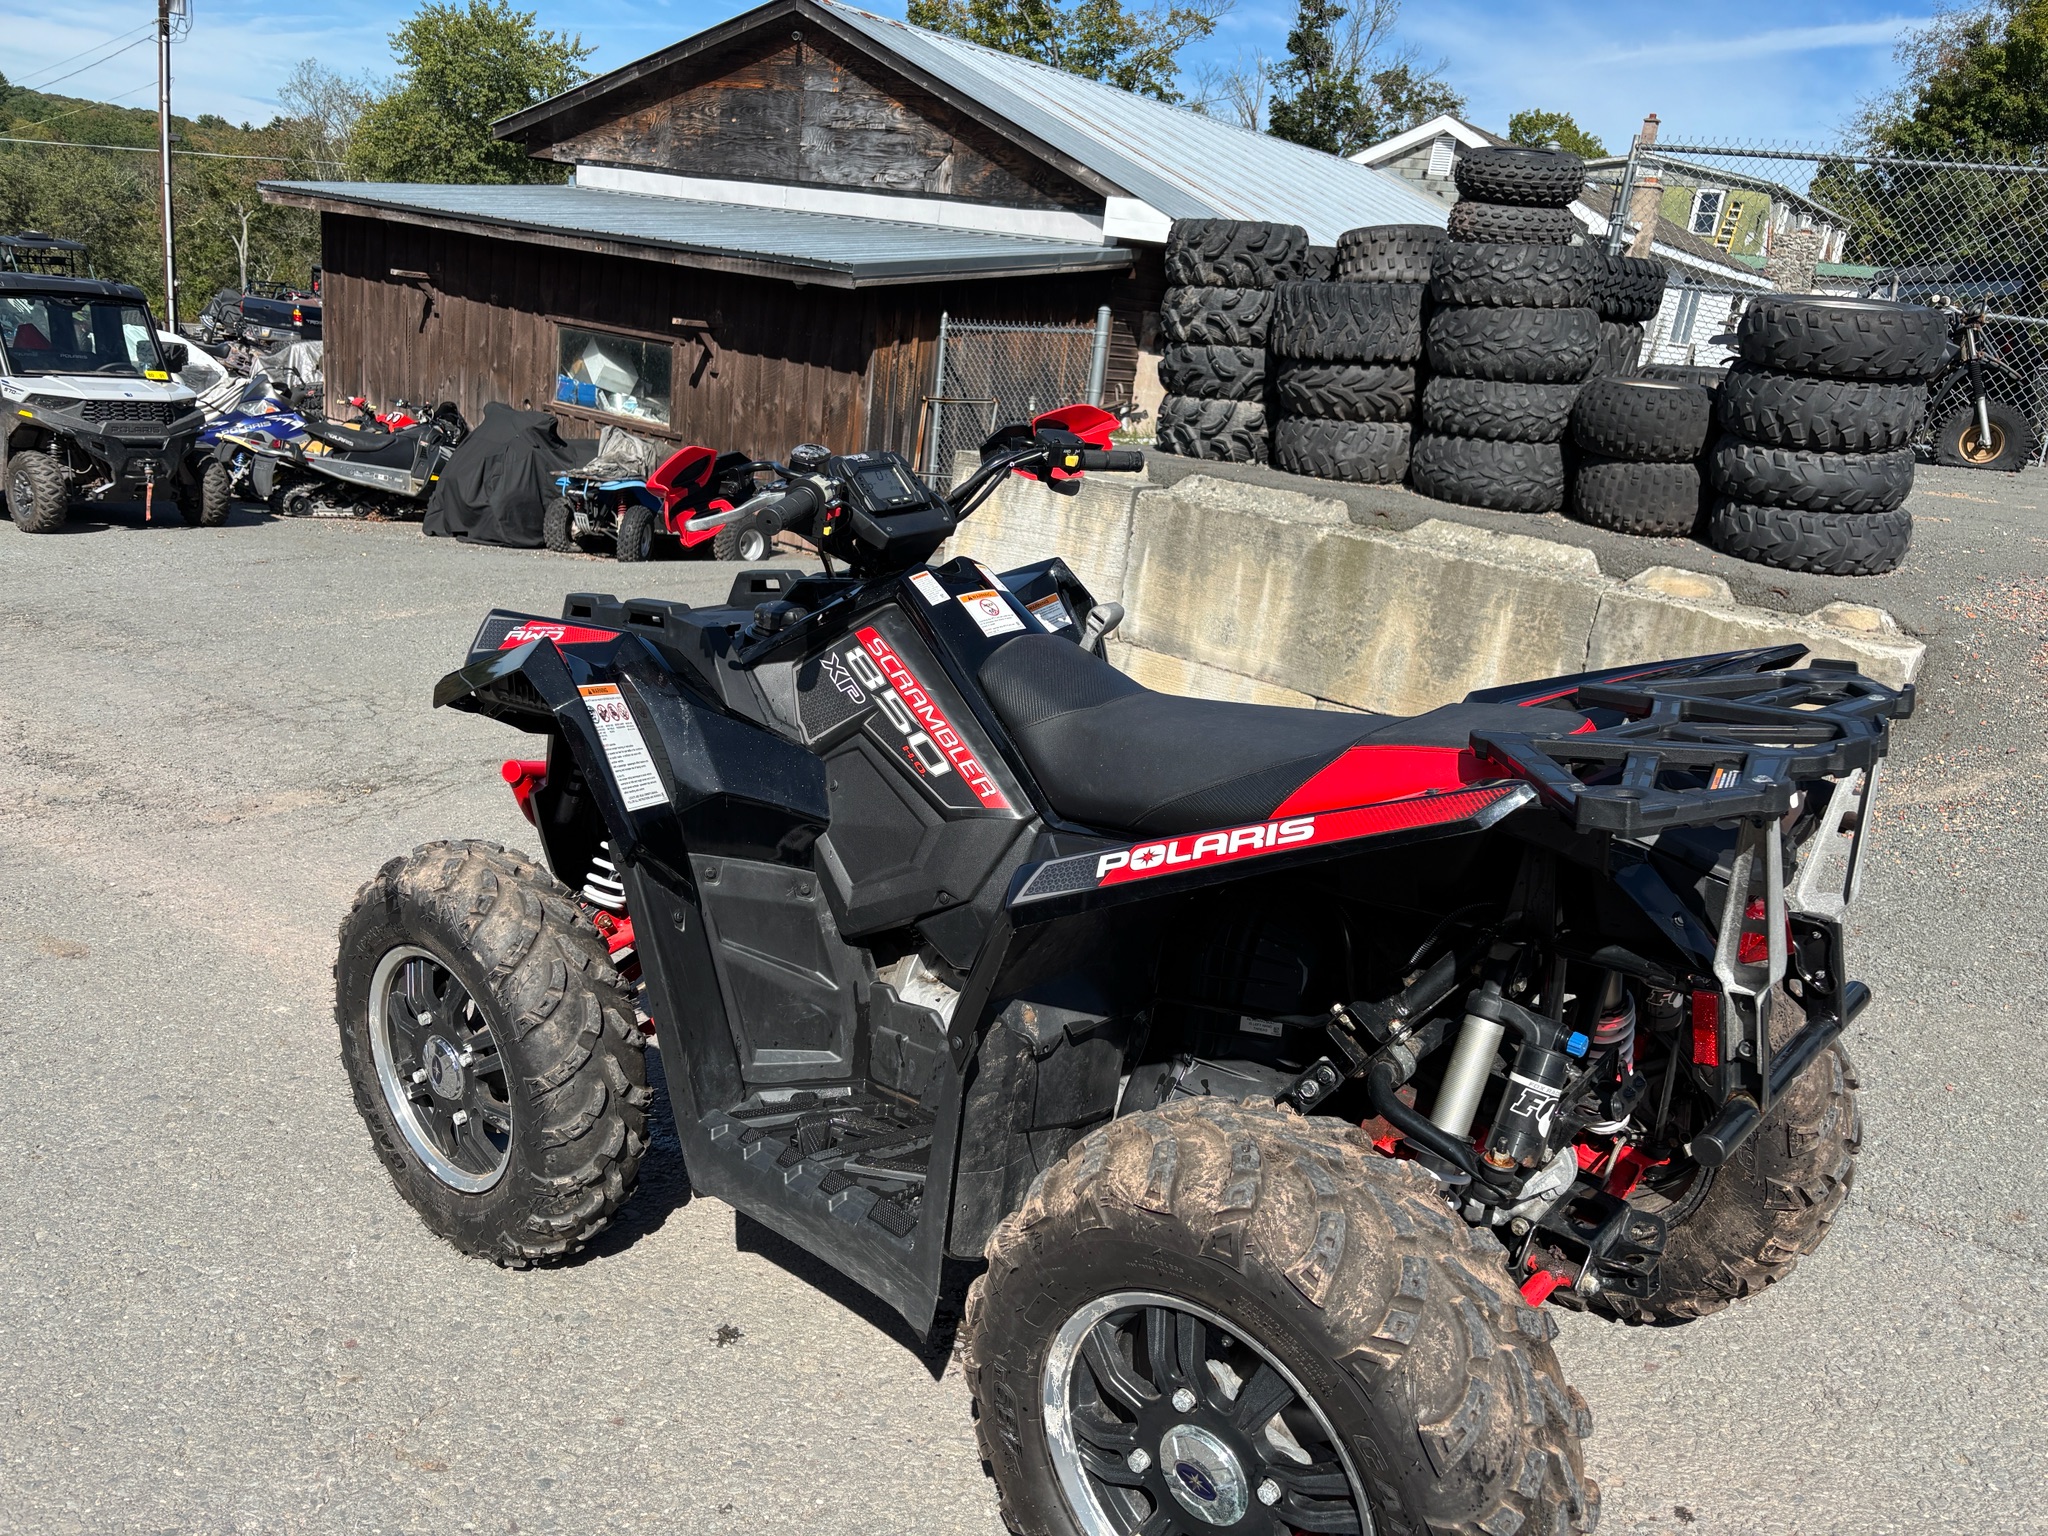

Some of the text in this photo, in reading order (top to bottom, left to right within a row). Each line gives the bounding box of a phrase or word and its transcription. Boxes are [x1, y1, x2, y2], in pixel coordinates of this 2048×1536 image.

[111, 425, 162, 434] POLARIS
[503, 630, 565, 641] AWD
[819, 651, 866, 704] XP
[844, 647, 952, 778] 850
[866, 636, 997, 799] SCRAMBLER
[1096, 816, 1316, 878] POLARIS
[1646, 989, 1684, 1009] FO
[1528, 1081, 1546, 1091] FOX
[1509, 1087, 1560, 1138] FO
